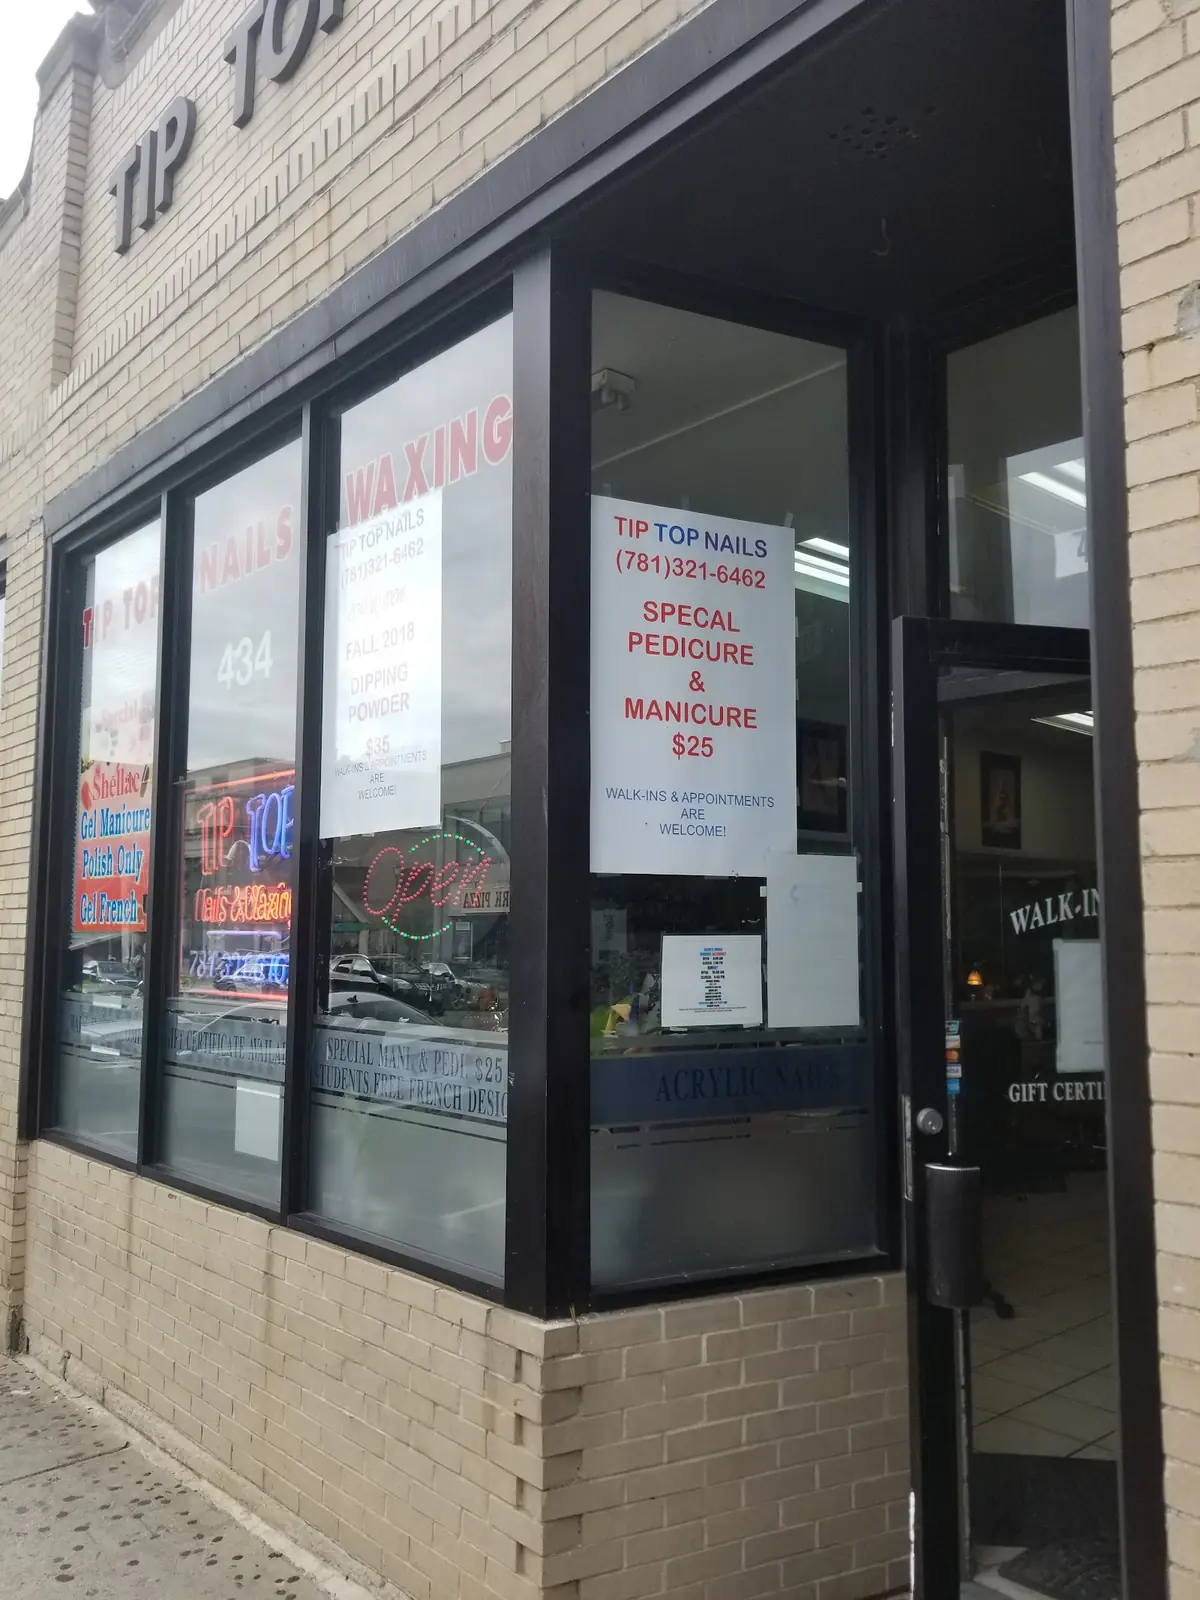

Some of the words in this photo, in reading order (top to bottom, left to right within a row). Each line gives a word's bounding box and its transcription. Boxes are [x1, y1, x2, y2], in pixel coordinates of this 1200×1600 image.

[109, 96, 197, 256] TIP
[224, 0, 344, 129] TO
[345, 393, 513, 529] WAXING
[359, 528, 384, 552] TOP
[386, 508, 425, 541] NAILS
[614, 515, 649, 539] TIP
[654, 523, 699, 547] TOP
[704, 531, 768, 558] NAILS
[199, 503, 294, 596] NAILS
[616, 549, 766, 589] (781)321-6462
[82, 600, 114, 649] TIP
[643, 601, 741, 633] SPECAL
[345, 633, 379, 661] FALL
[383, 620, 415, 649] 2018
[628, 632, 754, 666] PEDICURE
[217, 629, 274, 691] 434
[350, 662, 409, 696] DIPPING
[688, 670, 705, 692] &
[348, 692, 410, 724] POWDER
[625, 697, 758, 729] MANICURE
[365, 734, 391, 762] $35
[672, 731, 714, 760] $25
[91, 763, 141, 801] Shellac
[369, 773, 385, 785] ARE
[606, 787, 667, 803] WALK-INS
[670, 790, 680, 803] &
[682, 792, 775, 808] APPOINTMENTS
[680, 808, 705, 820] ARE
[81, 809, 97, 840] Gel
[99, 804, 151, 838] Manicure
[196, 796, 235, 876] TIP
[659, 823, 727, 838] WELCOME!
[82, 846, 114, 880] Polish
[116, 843, 144, 884] Only
[363, 846, 492, 923] Open
[80, 893, 97, 924] Gel
[98, 891, 138, 924] French
[186, 1028, 246, 1060] CERTIFICATE
[327, 1037, 374, 1066] SPECIAL
[418, 1048, 429, 1073] &
[474, 1056, 504, 1083] $25
[374, 1071, 404, 1101] FREE
[409, 1077, 464, 1111] FRENCH
[656, 1065, 766, 1102] ACRYLIC
[1008, 1082, 1049, 1103] GIFT
